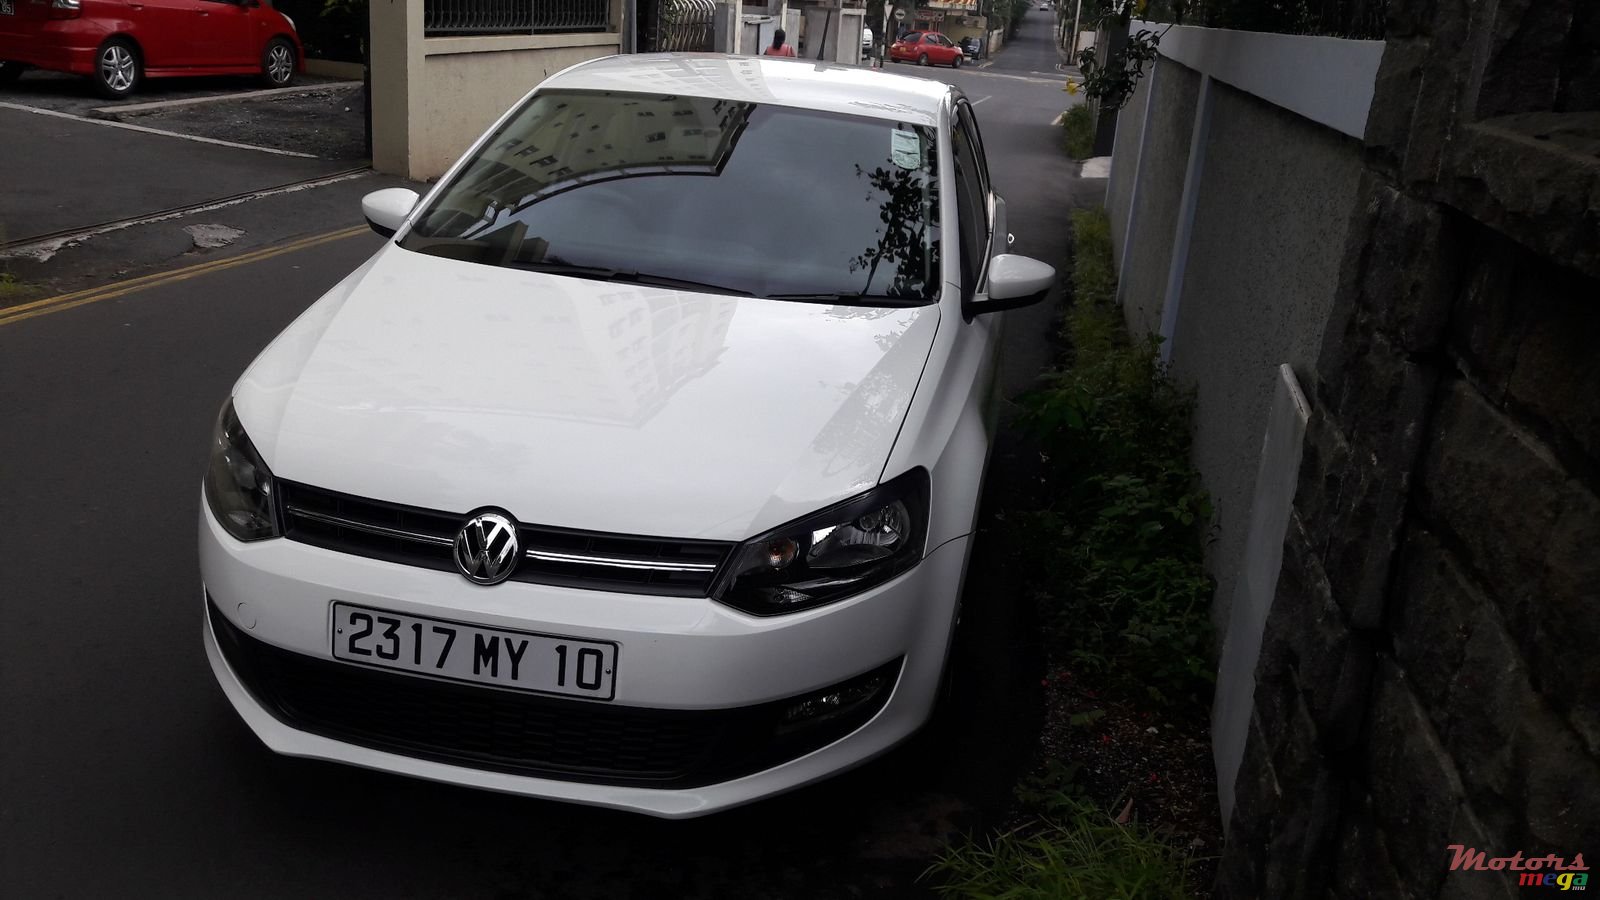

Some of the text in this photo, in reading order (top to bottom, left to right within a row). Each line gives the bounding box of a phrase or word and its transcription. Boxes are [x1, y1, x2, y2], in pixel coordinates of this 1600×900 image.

[349, 612, 603, 690] 2317 MY 10
